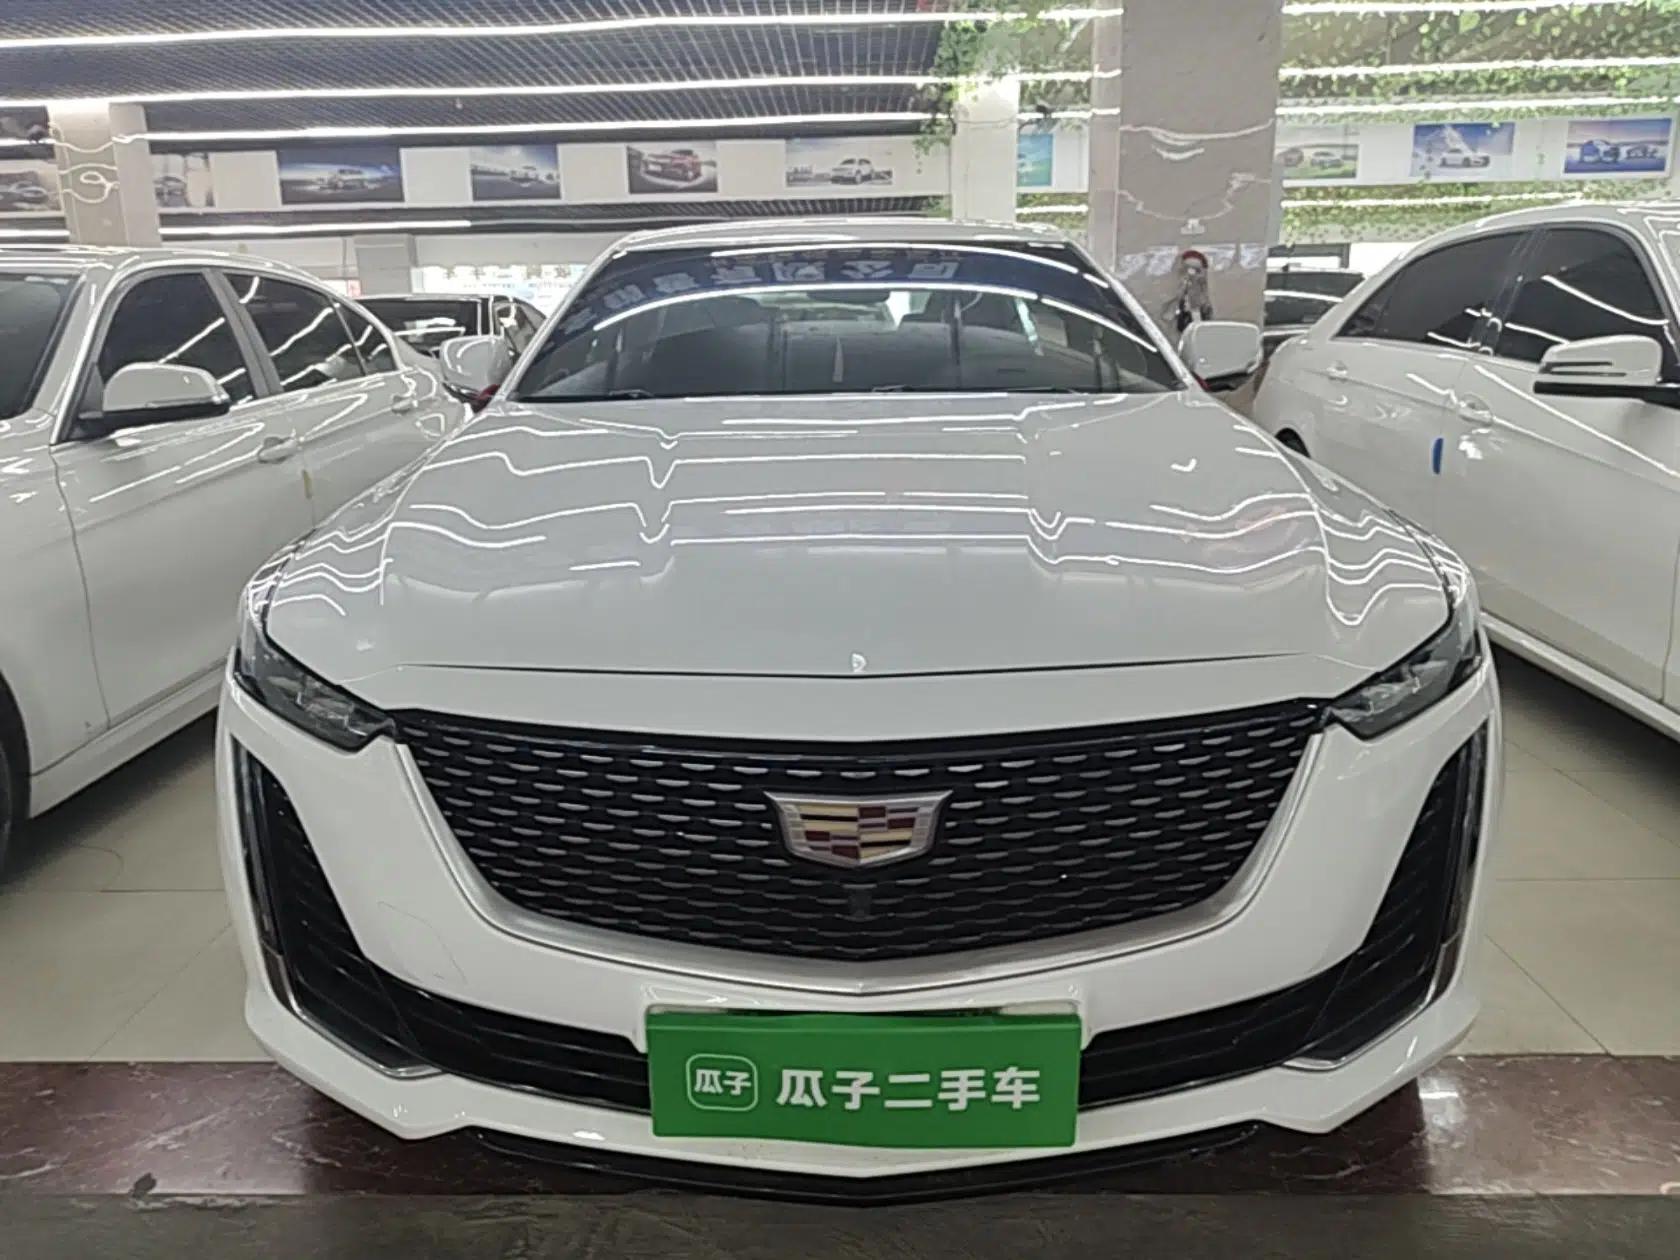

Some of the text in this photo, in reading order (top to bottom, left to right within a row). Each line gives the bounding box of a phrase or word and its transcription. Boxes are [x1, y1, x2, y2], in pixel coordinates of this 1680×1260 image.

[694, 1069, 752, 1095] 瓜子
[776, 1066, 1041, 1110] 瓜子二手车
